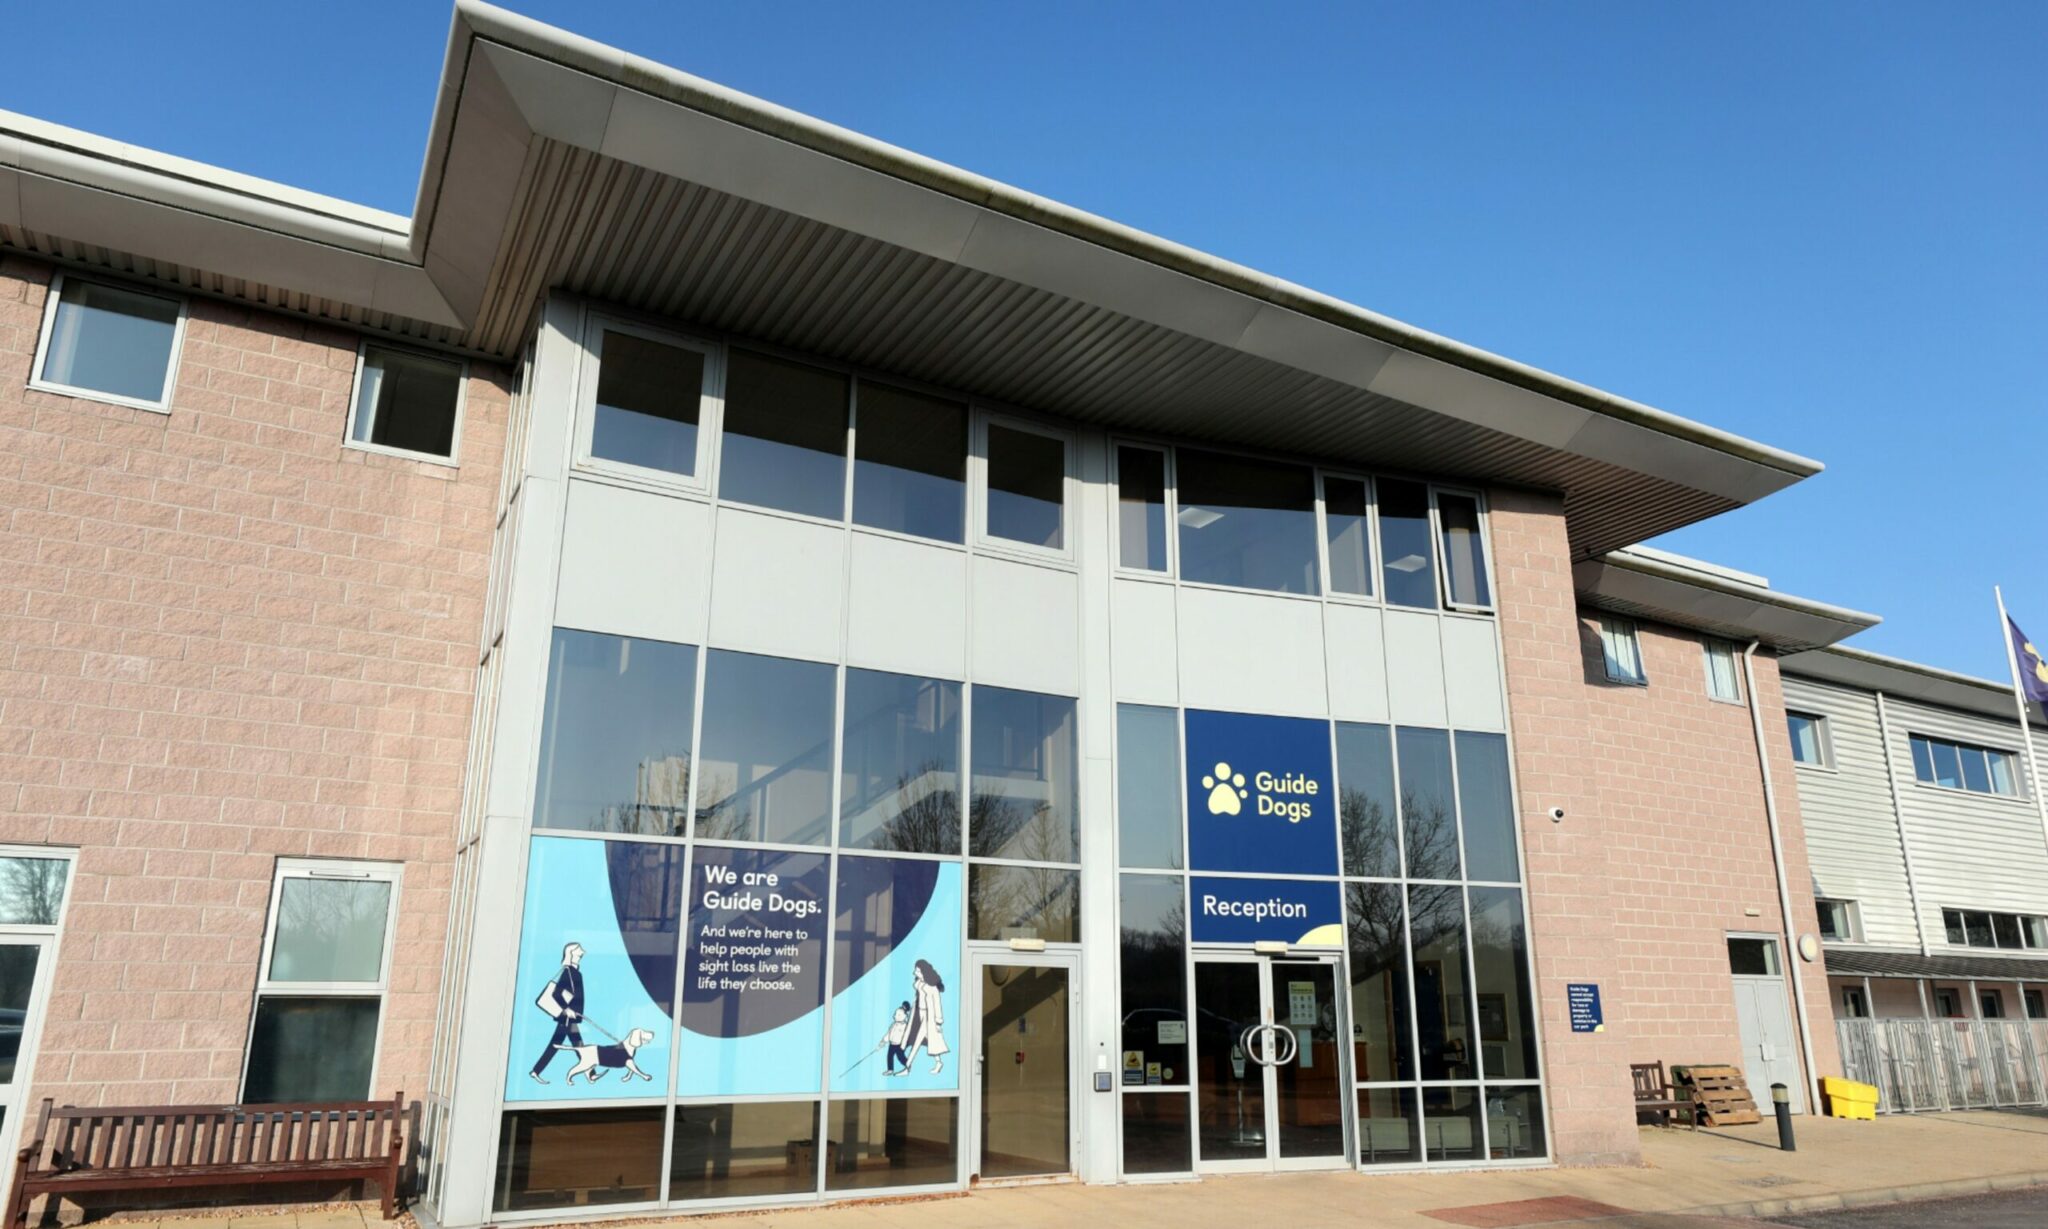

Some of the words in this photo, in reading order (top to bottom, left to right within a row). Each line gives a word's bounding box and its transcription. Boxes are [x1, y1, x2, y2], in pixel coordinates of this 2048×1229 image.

[1255, 771, 1319, 795] Guide
[1257, 795, 1312, 823] Dogs
[705, 865, 737, 884] We
[742, 873, 778, 886] are
[703, 891, 763, 911] Guide
[768, 893, 822, 918] Dogs.
[1203, 895, 1307, 922] Reception
[701, 925, 726, 937] And
[764, 927, 793, 940] here
[796, 929, 808, 940] to
[700, 942, 727, 958] help
[730, 944, 772, 958] people
[774, 945, 799, 957] with
[698, 960, 729, 975] sight
[732, 961, 755, 973] loss
[758, 961, 779, 973] live
[781, 962, 801, 973] the
[698, 977, 717, 990] life
[720, 978, 747, 993] they
[749, 979, 795, 990] choose.
